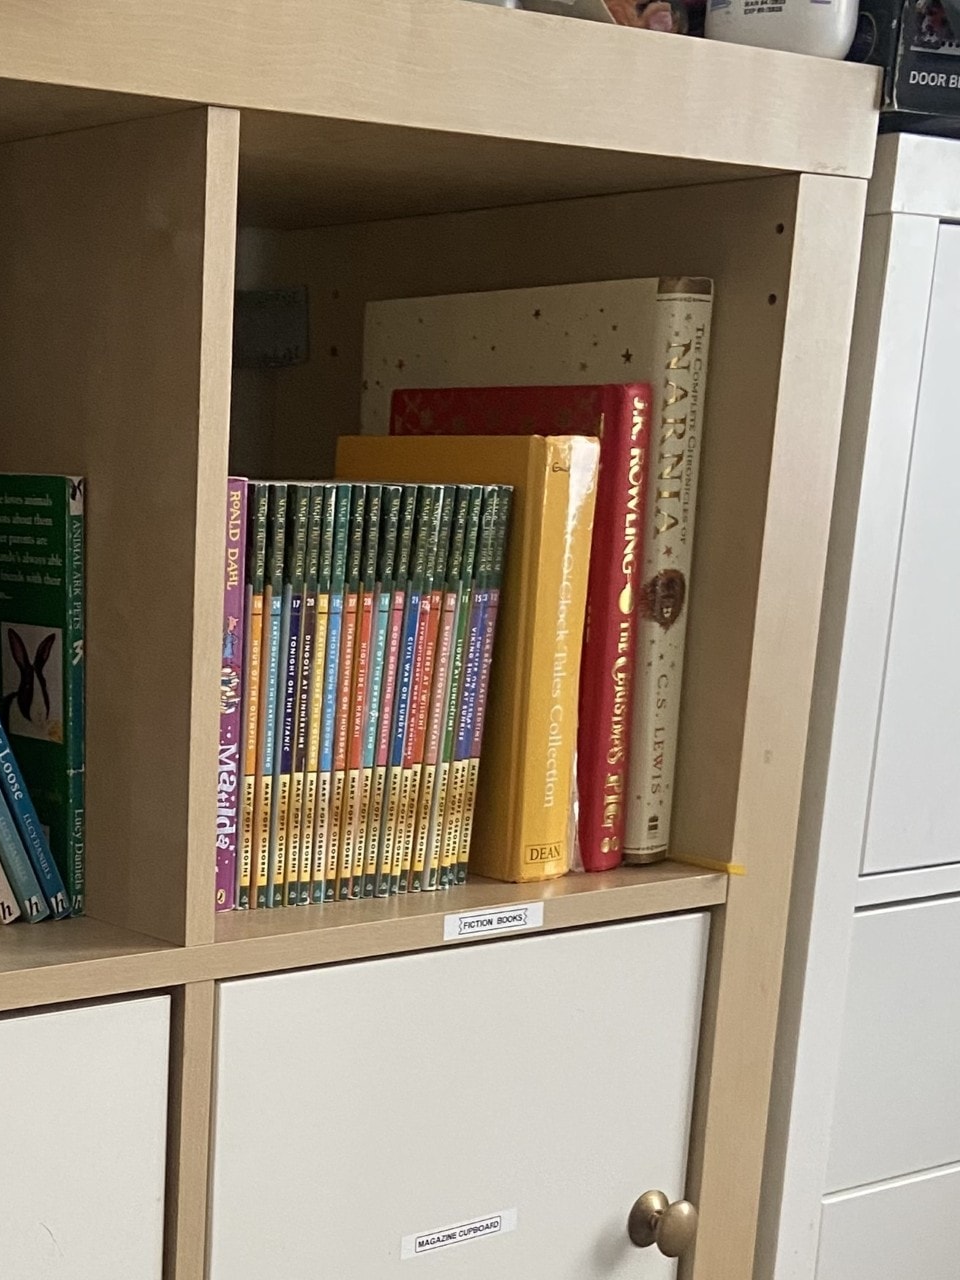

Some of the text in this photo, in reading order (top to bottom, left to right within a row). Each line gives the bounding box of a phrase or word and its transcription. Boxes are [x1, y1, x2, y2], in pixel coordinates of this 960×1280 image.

[909, 70, 947, 88] DOOR
[654, 339, 692, 541] NARNIA
[679, 323, 706, 545] THE COMPLETE CHRONICLES OF
[622, 397, 648, 575] J.K. ROWLING
[226, 490, 242, 590] ROALD DAHL
[71, 519, 83, 631] ANIMAL ARK PETS
[288, 636, 297, 677] TONIGHT
[302, 635, 312, 677] DINGOES
[401, 663, 411, 685] WAR
[404, 636, 414, 660] CIVIL
[543, 553, 575, 808] O'Clock Tales Collection
[283, 717, 293, 753] TITANIC
[297, 694, 308, 750] DINNERTIME
[395, 703, 407, 740] SUNDAY
[602, 618, 632, 830] THE CHRISTMAS PIG
[649, 673, 669, 797] C.S. LEWIS
[216, 743, 238, 850] Matilda
[23, 813, 51, 880] LUCY DANIELS
[70, 808, 83, 889] Lucy Daniels
[276, 835, 285, 876] OSBORNE
[529, 844, 561, 861] DEAN
[462, 913, 524, 931] FICTION BOOKS
[418, 1220, 500, 1248] MAGAZINE CUPBOARD
